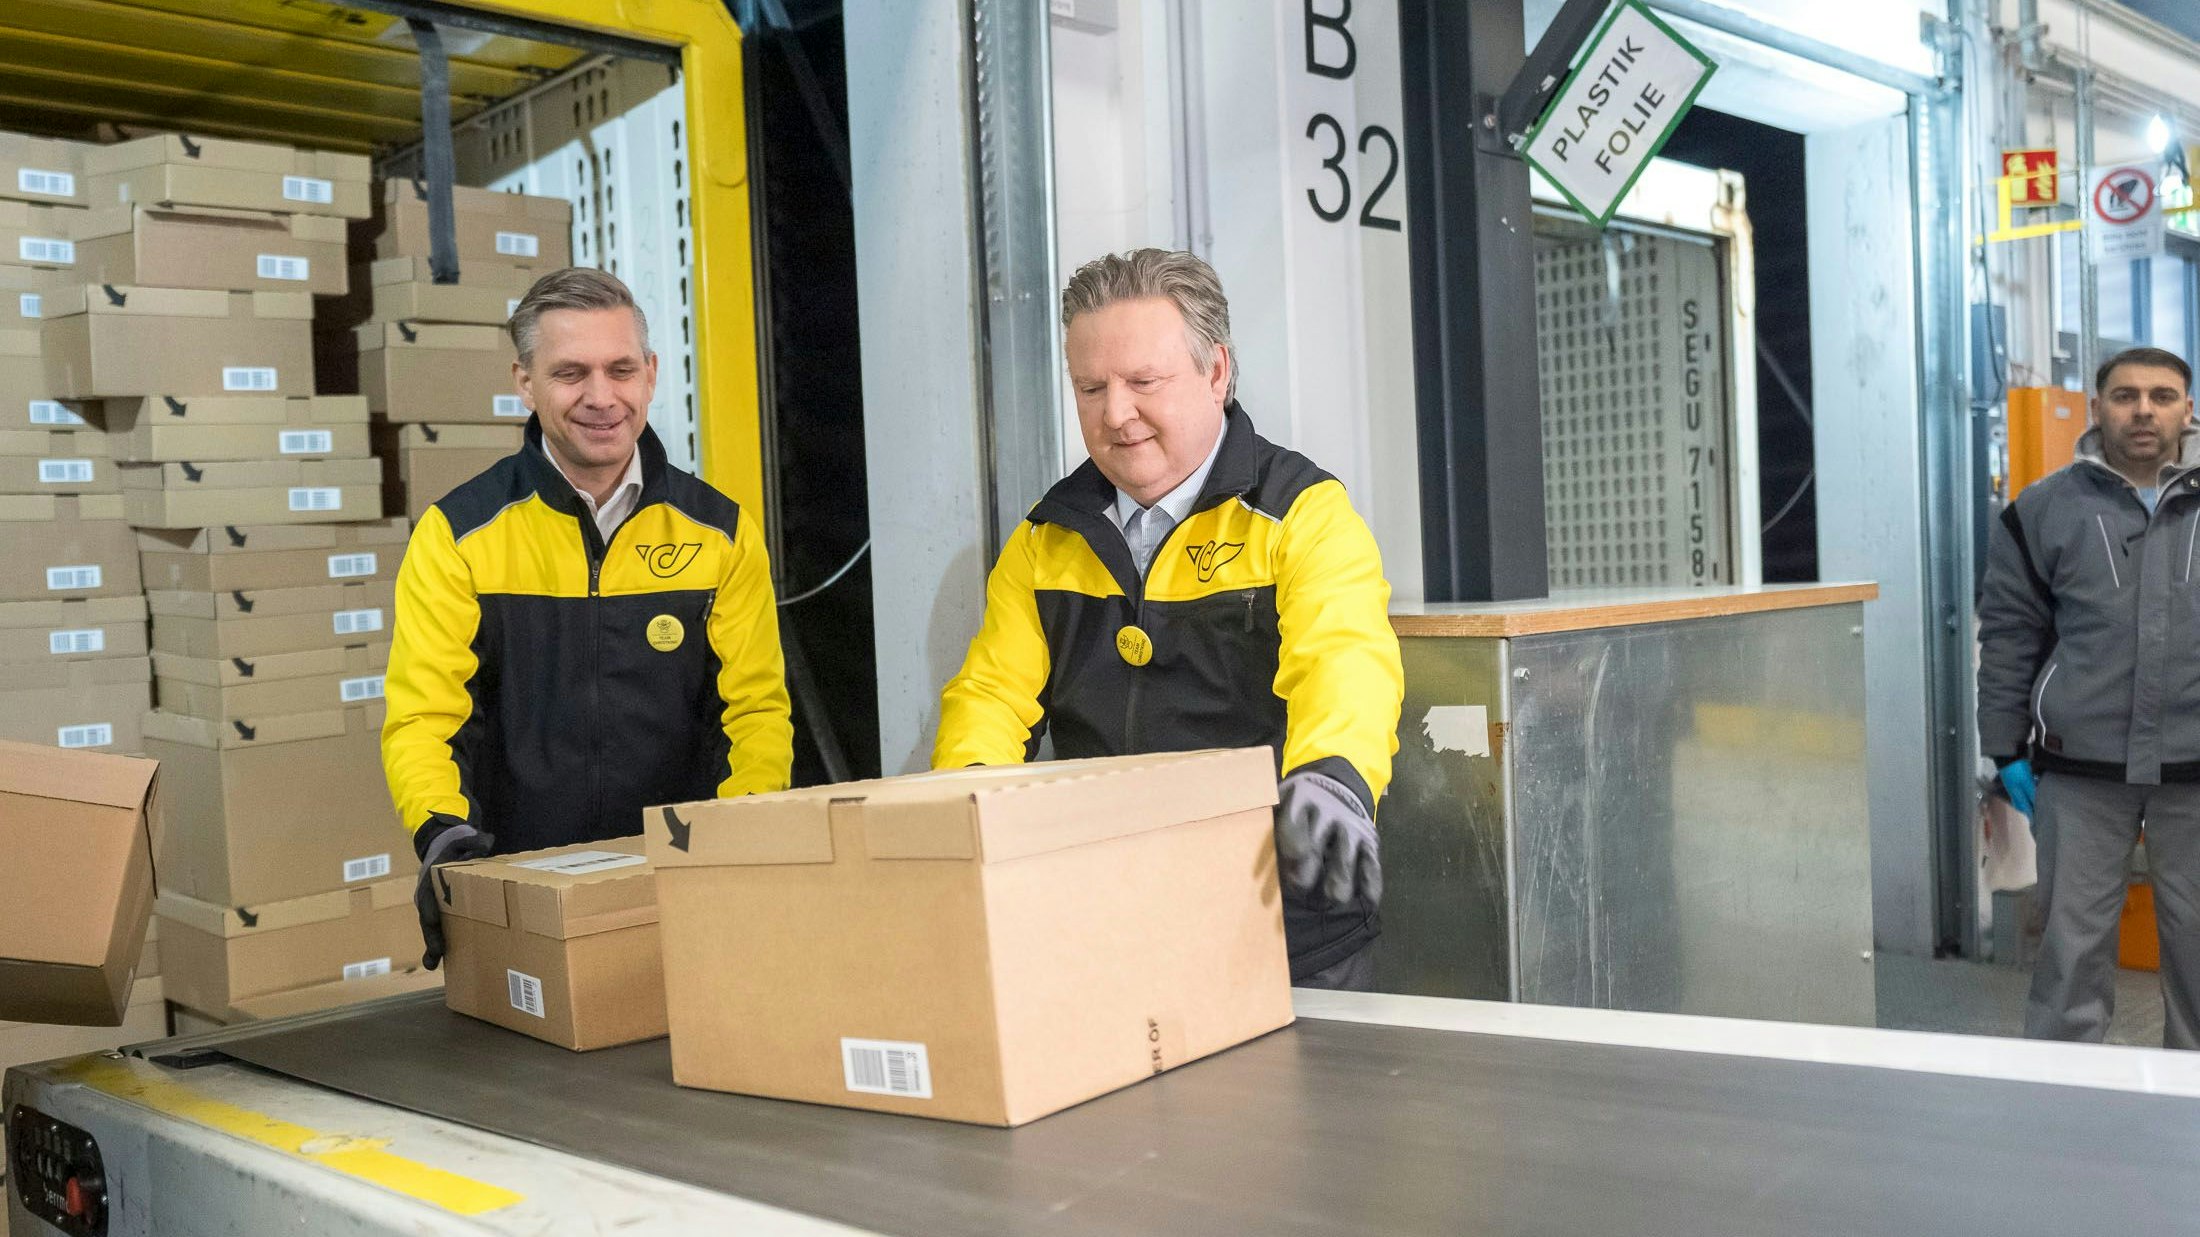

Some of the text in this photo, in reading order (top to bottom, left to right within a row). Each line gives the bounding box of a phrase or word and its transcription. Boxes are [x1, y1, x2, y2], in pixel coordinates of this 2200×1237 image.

[1304, 0, 1356, 80] B
[1552, 35, 1645, 163] PLASTIK
[1306, 113, 1401, 232] 32
[1594, 82, 1666, 175] FOLIE
[1683, 300, 1704, 587] SEGU 7158
